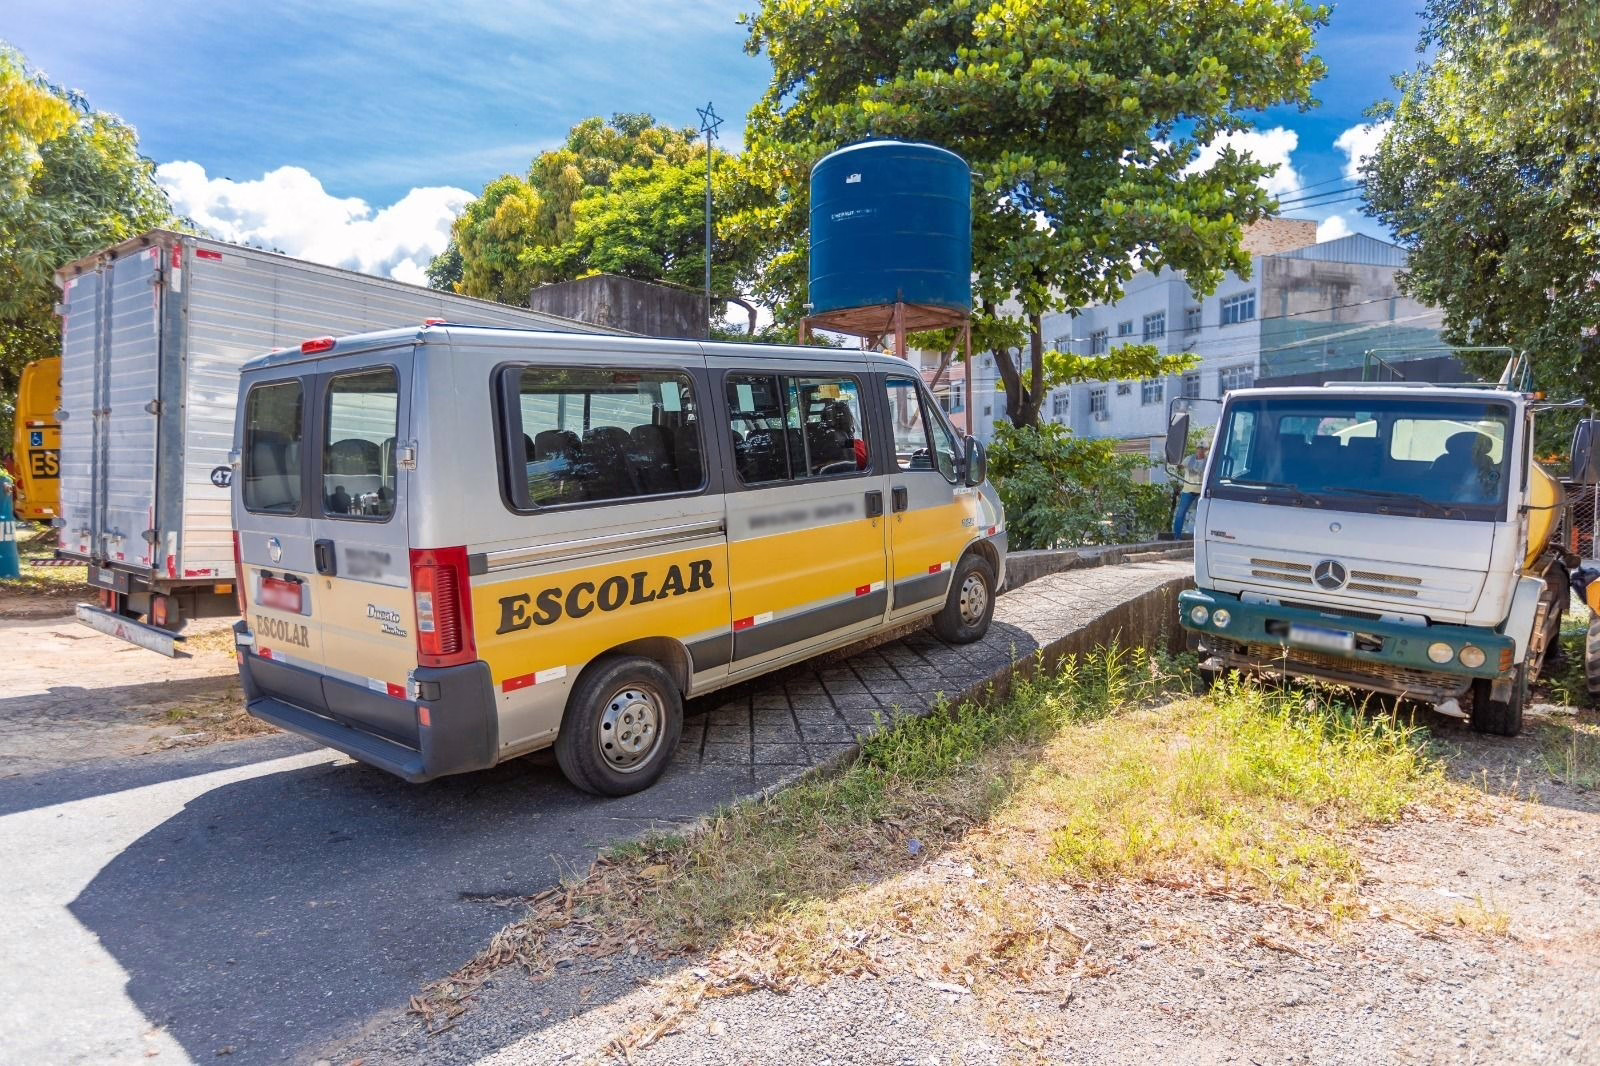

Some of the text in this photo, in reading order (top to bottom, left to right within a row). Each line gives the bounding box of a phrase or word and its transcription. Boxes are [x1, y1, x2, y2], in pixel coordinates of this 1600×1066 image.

[212, 470, 232, 484] 47
[496, 559, 715, 635] ESCOLAR
[367, 603, 401, 624] Ducato
[256, 614, 310, 648] ESCOLAR
